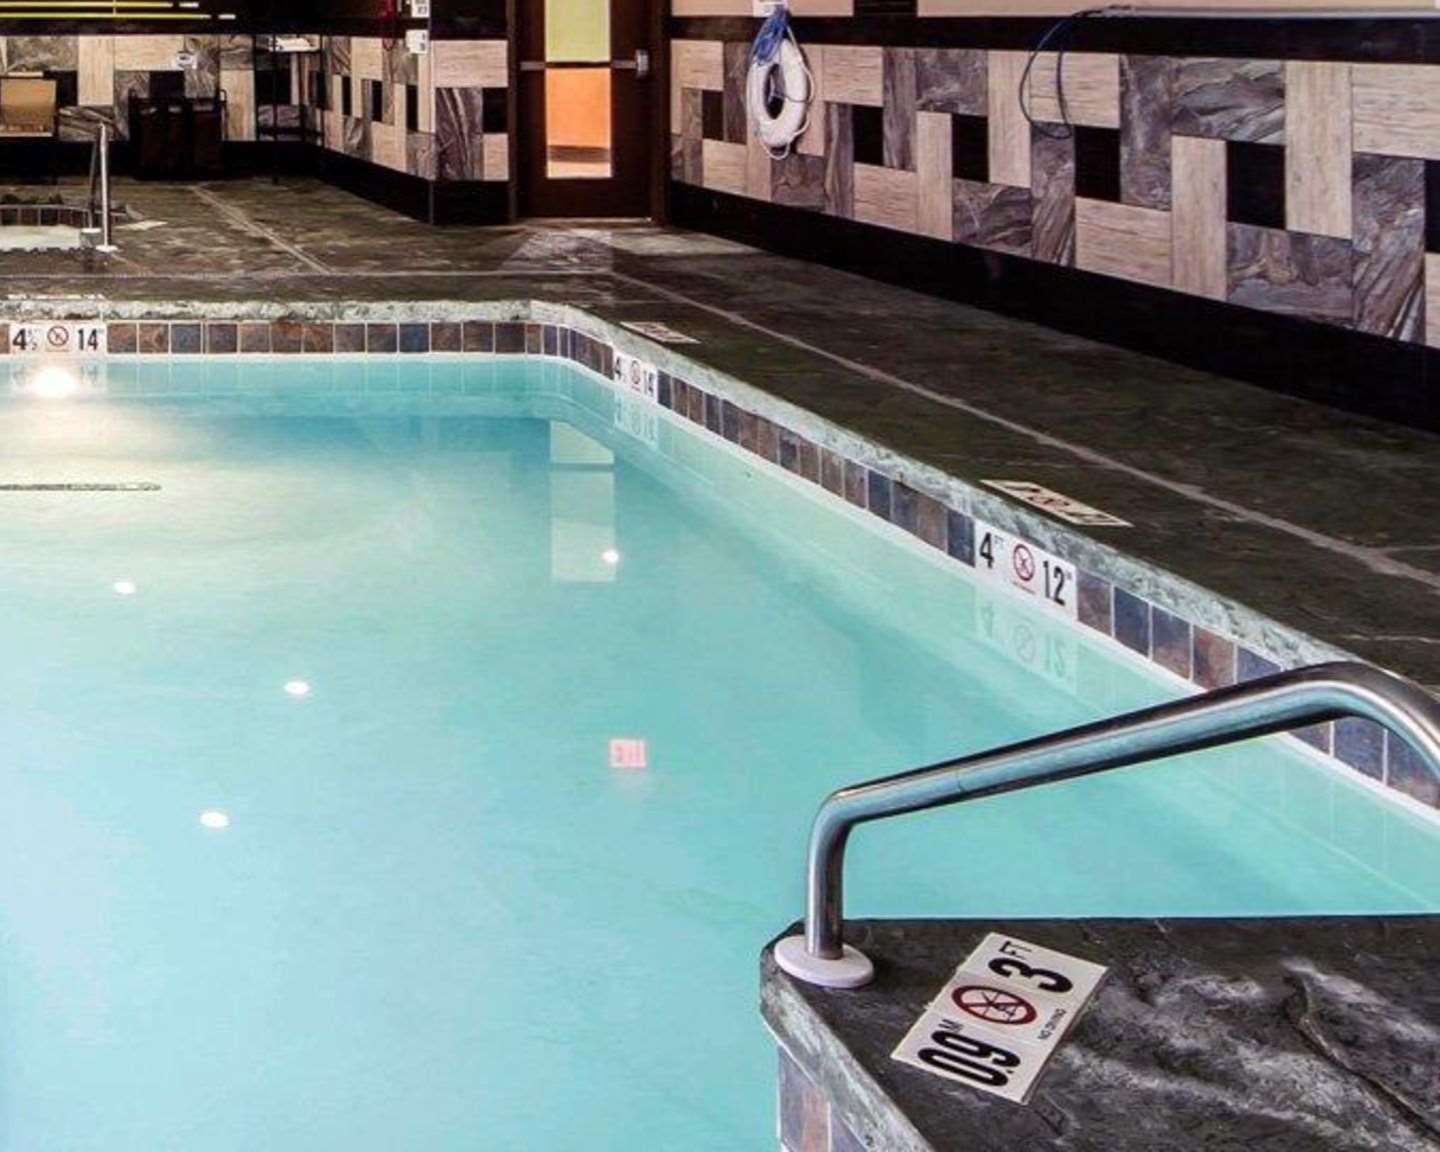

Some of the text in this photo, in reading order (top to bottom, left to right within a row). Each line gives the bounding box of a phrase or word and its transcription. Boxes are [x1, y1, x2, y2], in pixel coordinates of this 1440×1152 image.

[12, 328, 26, 350] 4
[979, 532, 994, 569] 4
[988, 958, 1073, 992] 3
